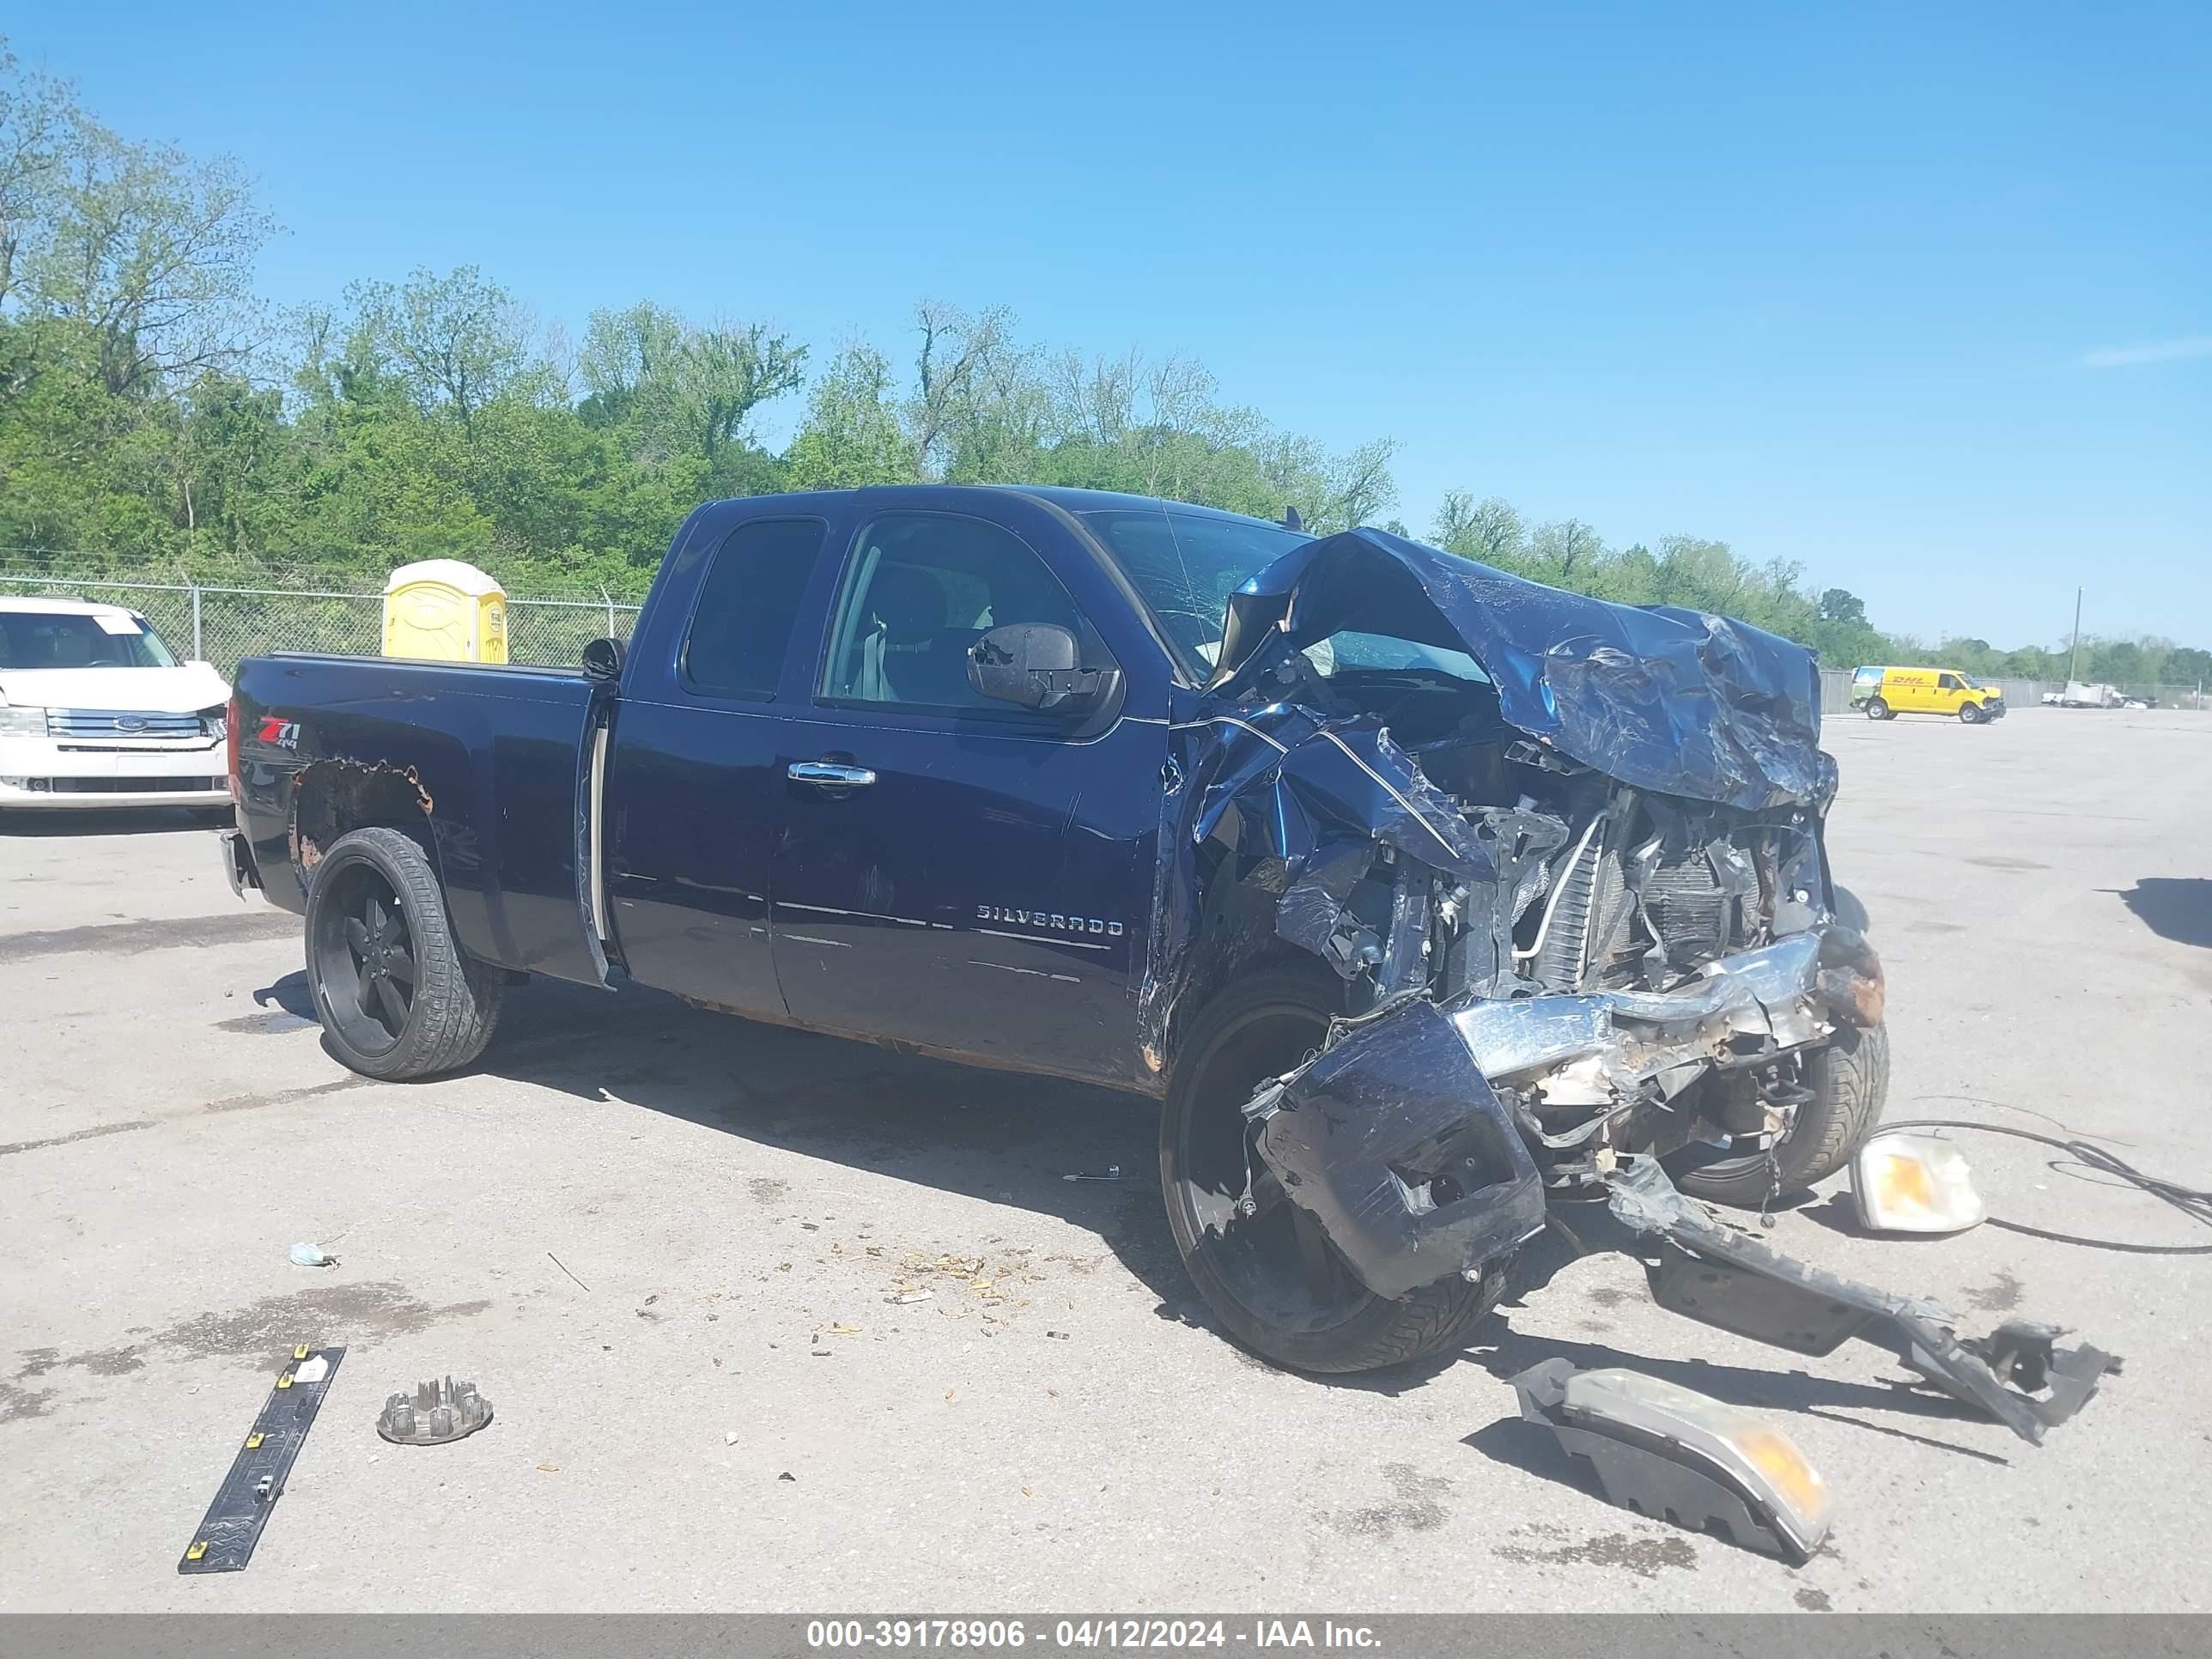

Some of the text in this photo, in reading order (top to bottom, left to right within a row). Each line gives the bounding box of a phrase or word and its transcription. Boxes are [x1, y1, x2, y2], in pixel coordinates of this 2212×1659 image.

[1892, 676, 1924, 684] DHL
[259, 716, 301, 742] Z71
[976, 904, 1123, 936] SILVERADO
